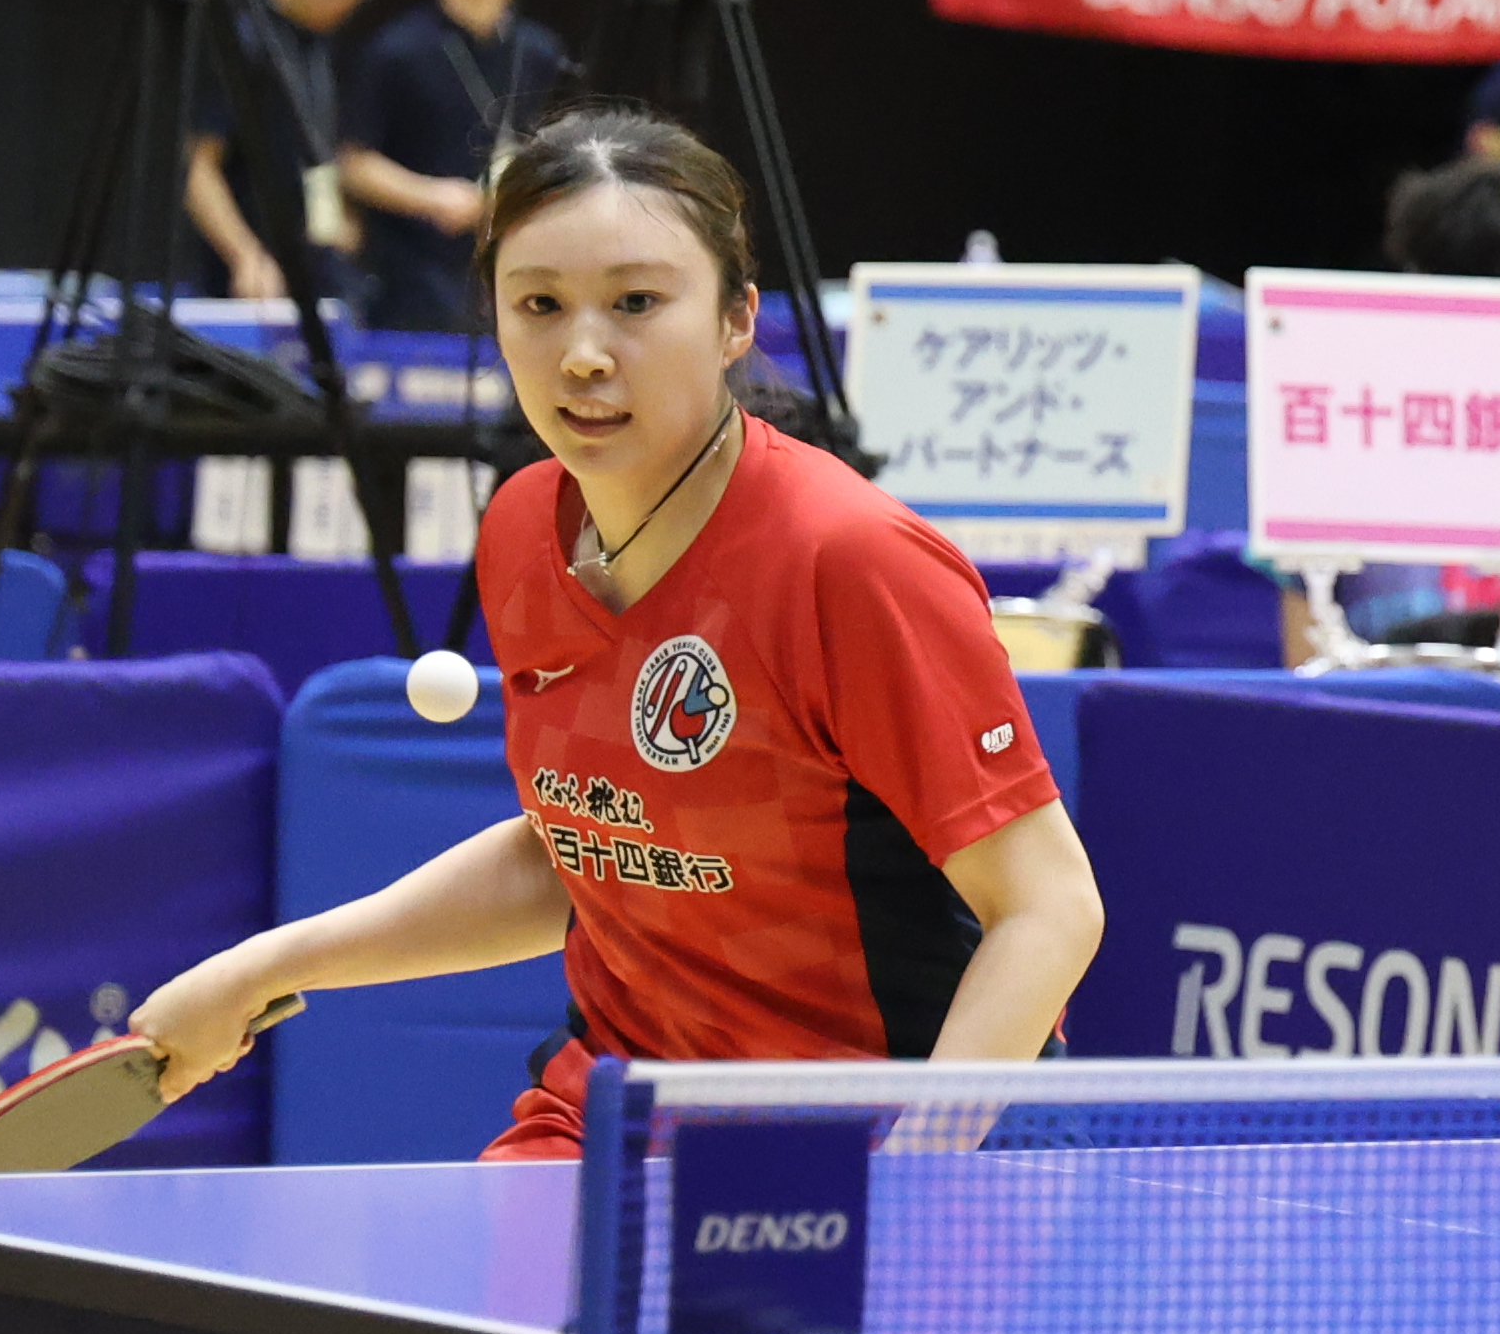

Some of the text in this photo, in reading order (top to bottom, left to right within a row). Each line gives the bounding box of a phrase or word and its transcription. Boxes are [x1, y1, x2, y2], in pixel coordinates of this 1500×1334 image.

[548, 824, 733, 892] 百十四銀行
[695, 1212, 848, 1252] DENSO
